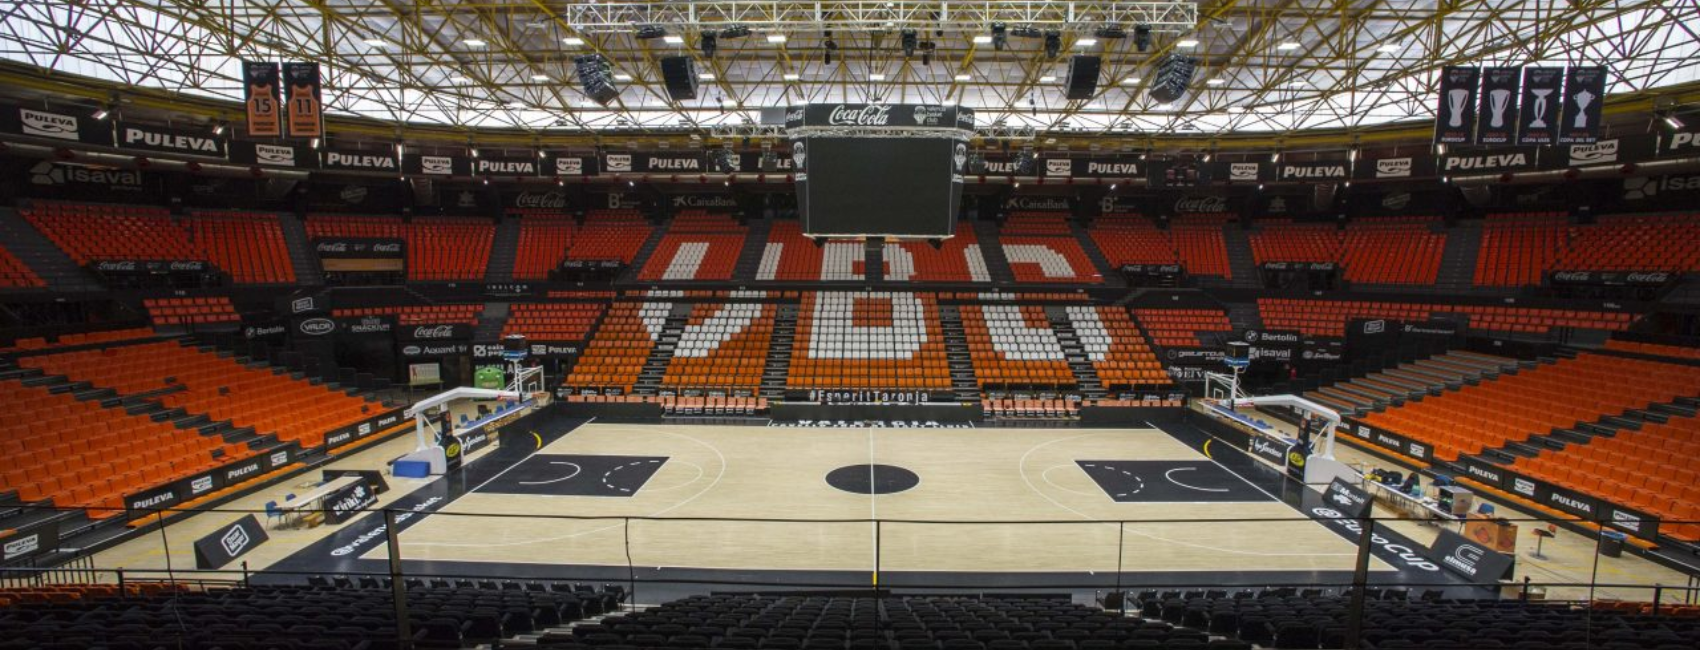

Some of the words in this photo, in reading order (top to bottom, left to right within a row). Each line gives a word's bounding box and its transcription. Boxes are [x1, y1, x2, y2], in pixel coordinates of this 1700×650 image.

[253, 98, 272, 114] 15
[296, 98, 312, 114] 11
[25, 112, 74, 126] PULEVA
[126, 127, 218, 152] PULEVA
[258, 146, 292, 155] PULEVA
[1573, 143, 1615, 153] PULEVA
[327, 152, 394, 169] PULEVA
[479, 160, 534, 173] PULEVA
[648, 157, 700, 170] PULEVA
[1379, 159, 1410, 167] PULEVA
[1445, 153, 1527, 170] PULEVA
[66, 164, 142, 186] isaval
[1088, 162, 1138, 175] PULEVA
[1283, 165, 1345, 178] PULEVA
[688, 194, 738, 206] CaixaBank
[1019, 197, 1070, 210] CaixaBank
[303, 322, 331, 331] VALOR
[548, 346, 577, 354] PULEVA
[227, 463, 259, 479] PULEVA
[1469, 465, 1499, 482] PULEVA
[133, 491, 174, 509] PULEVA
[1551, 493, 1590, 512] PULEVA
